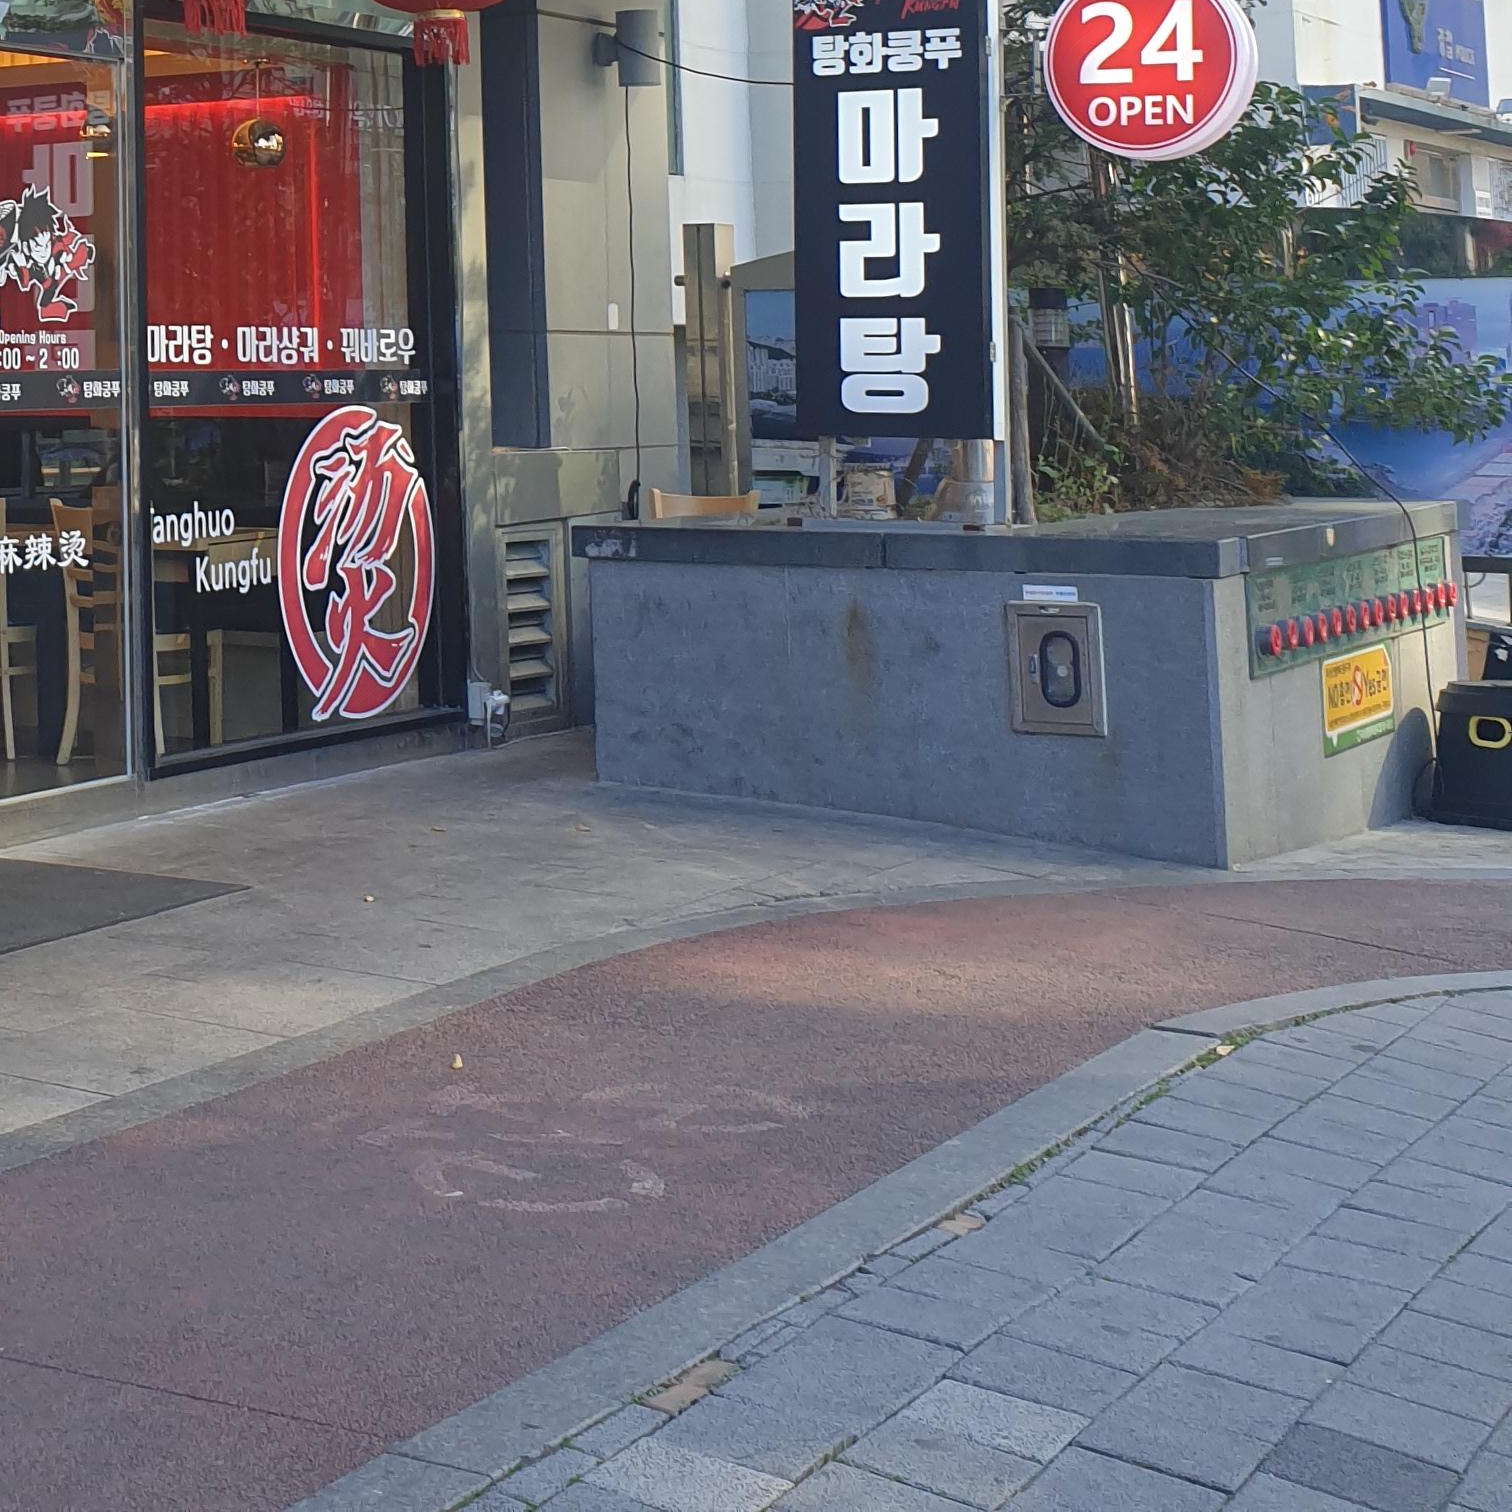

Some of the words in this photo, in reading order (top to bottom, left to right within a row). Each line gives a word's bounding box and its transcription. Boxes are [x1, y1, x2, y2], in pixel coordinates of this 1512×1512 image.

[811, 27, 963, 76] 탕화쿵푸
[1087, 94, 1195, 126] OPEN
[838, 87, 941, 413] 마라탕
[39, 330, 67, 344] Hours
[146, 324, 214, 365] 마라탕
[236, 325, 319, 365] 마라샹궈
[340, 327, 416, 365] 꿔바로우
[83, 380, 121, 399] 탕화쿵푸
[195, 547, 272, 594] Kungfu
